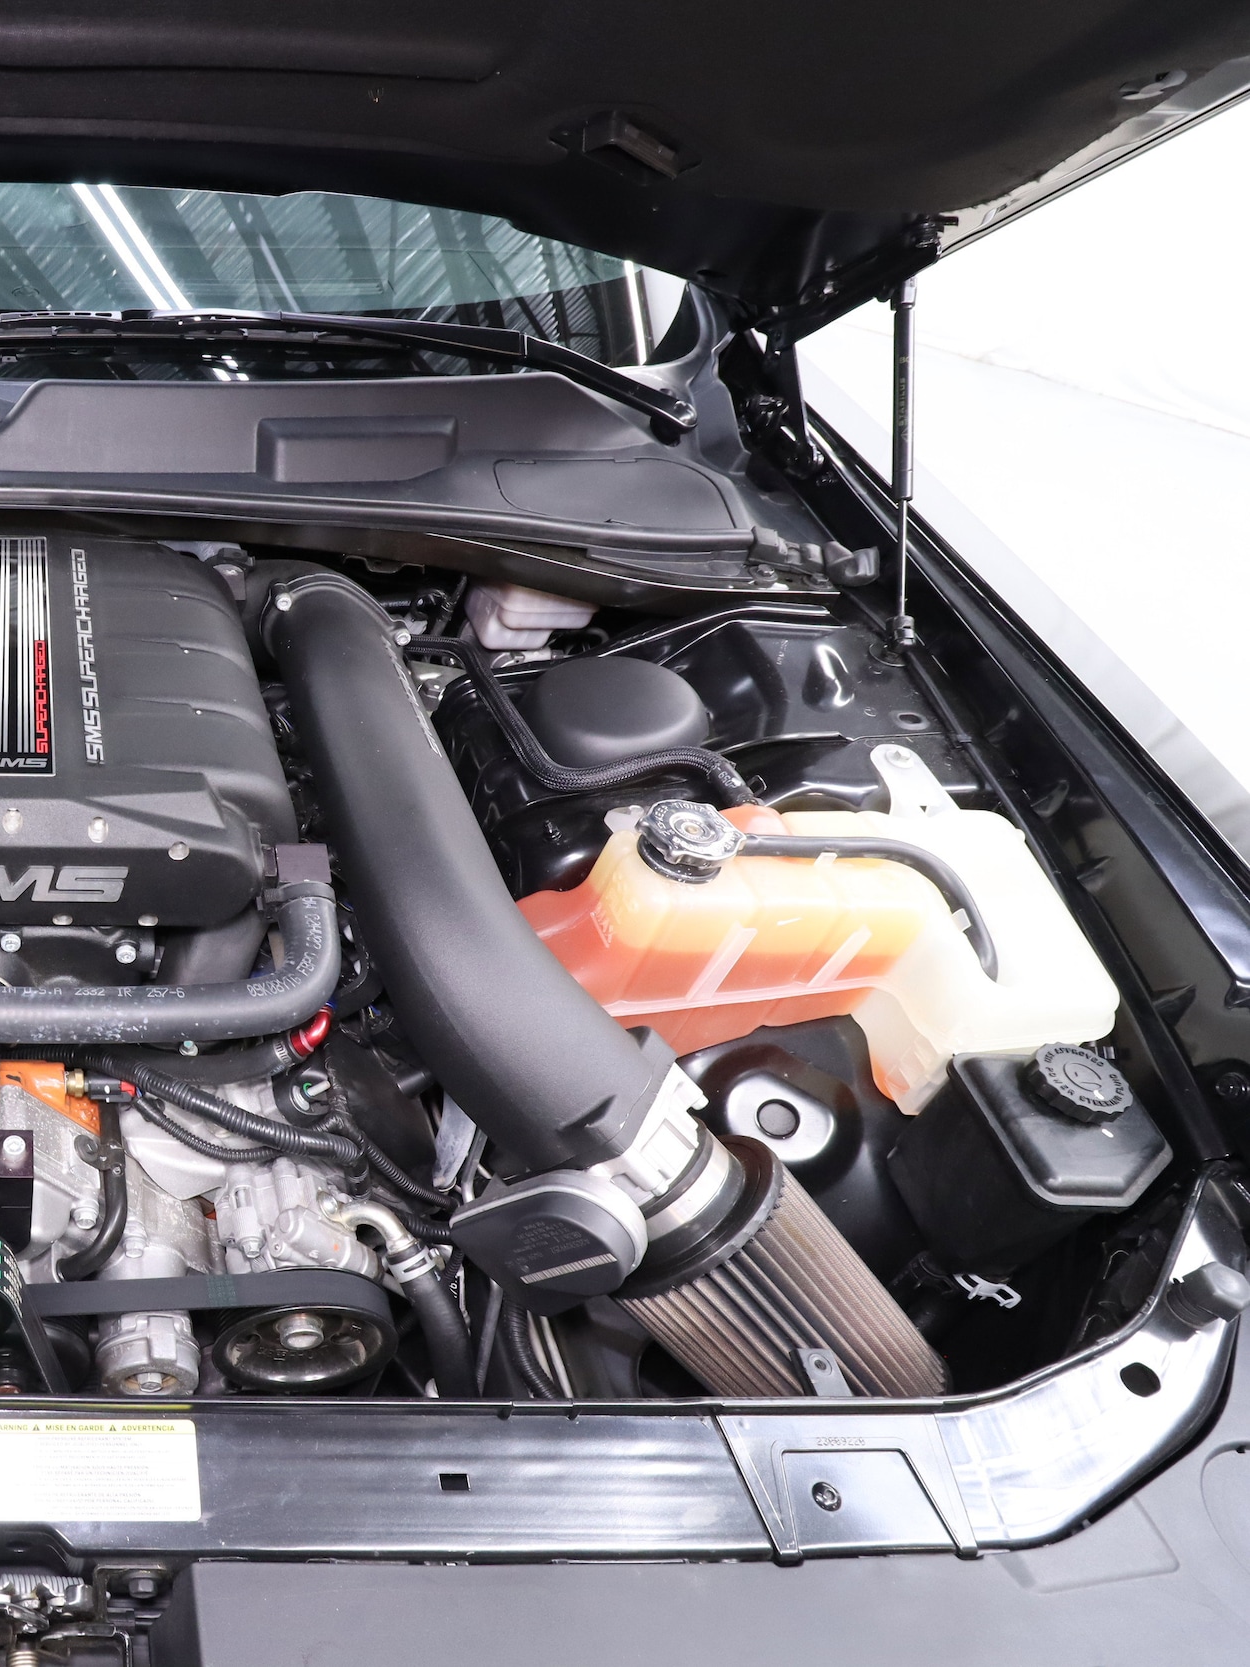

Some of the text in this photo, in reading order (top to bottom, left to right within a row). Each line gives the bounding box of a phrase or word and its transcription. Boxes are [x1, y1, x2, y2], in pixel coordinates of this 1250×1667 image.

[34, 640, 49, 753] SUPERCHARGED
[45, 1424, 64, 1432] MISE
[66, 1424, 77, 1432] EN
[78, 1424, 105, 1432] GARDE
[121, 1424, 175, 1432] ADVERTENCIA
